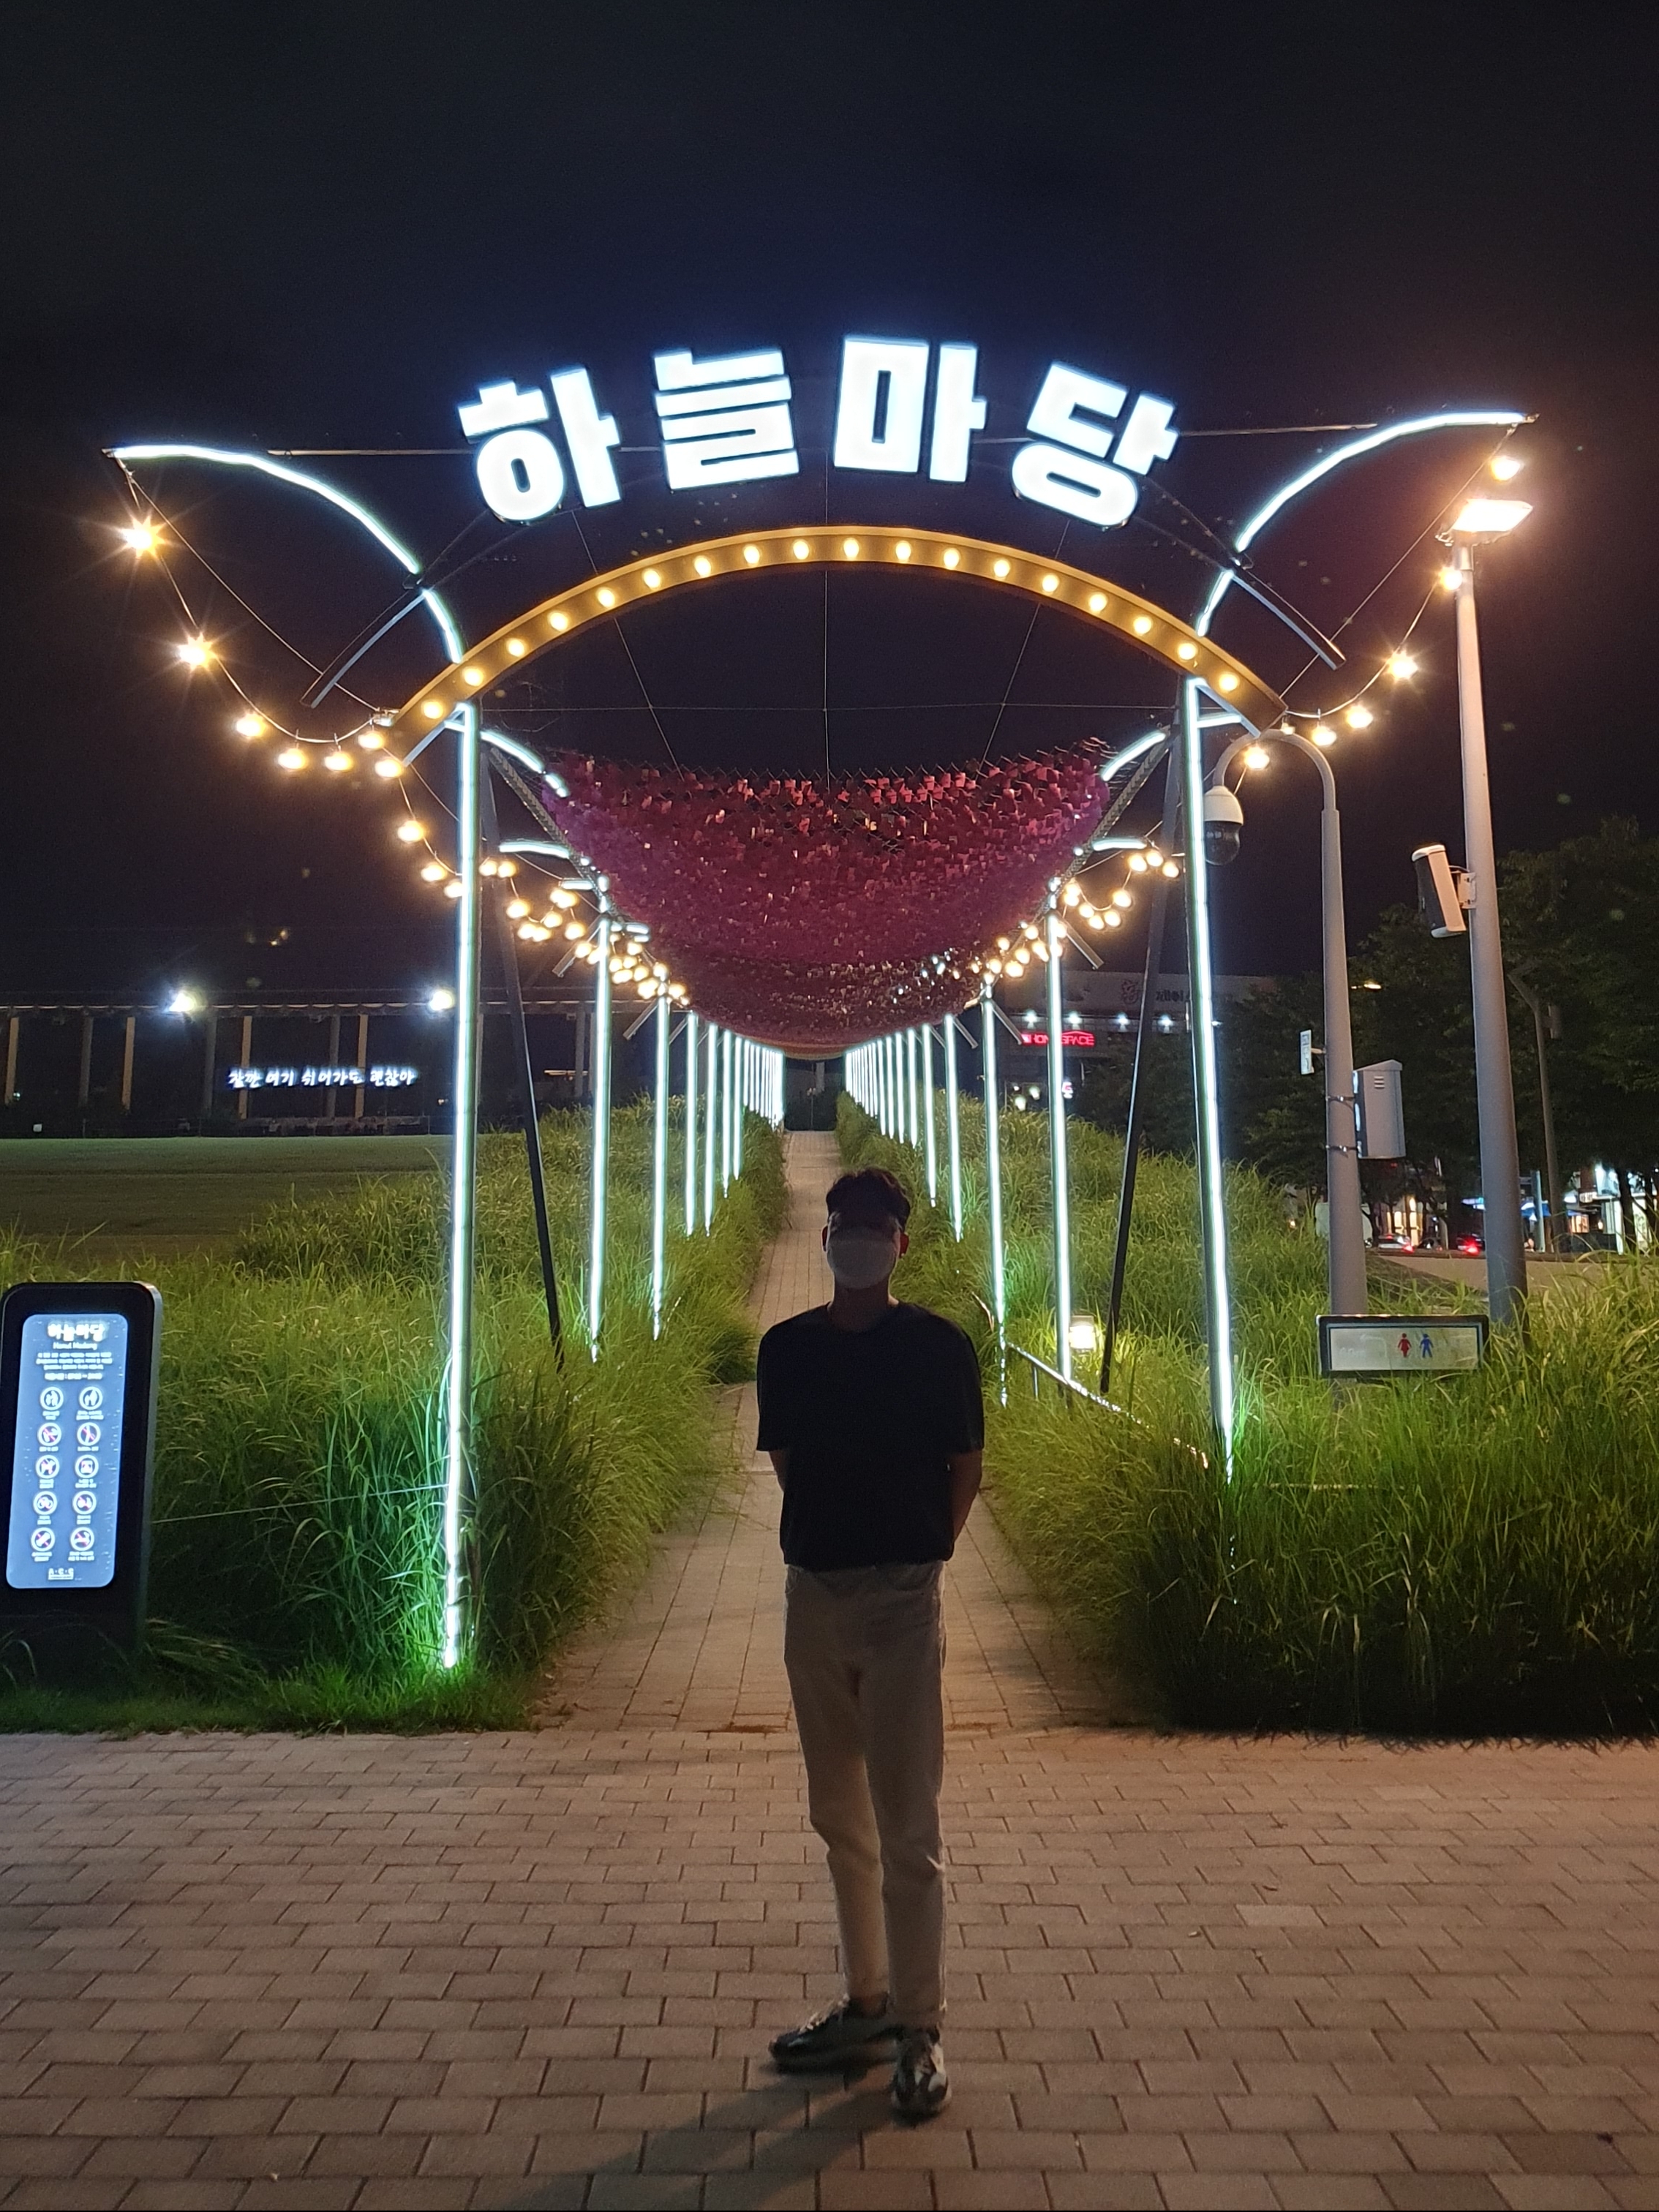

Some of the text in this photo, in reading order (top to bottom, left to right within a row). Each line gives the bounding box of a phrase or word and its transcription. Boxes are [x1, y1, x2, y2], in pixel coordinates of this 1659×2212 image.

[457, 335, 1178, 527] 하늘마당
[1062, 1035, 1095, 1045] SPACE
[228, 1066, 416, 1088] 잠깐 여기 쉬어가도 괜찮아
[48, 1323, 105, 1342] 하늘마당
